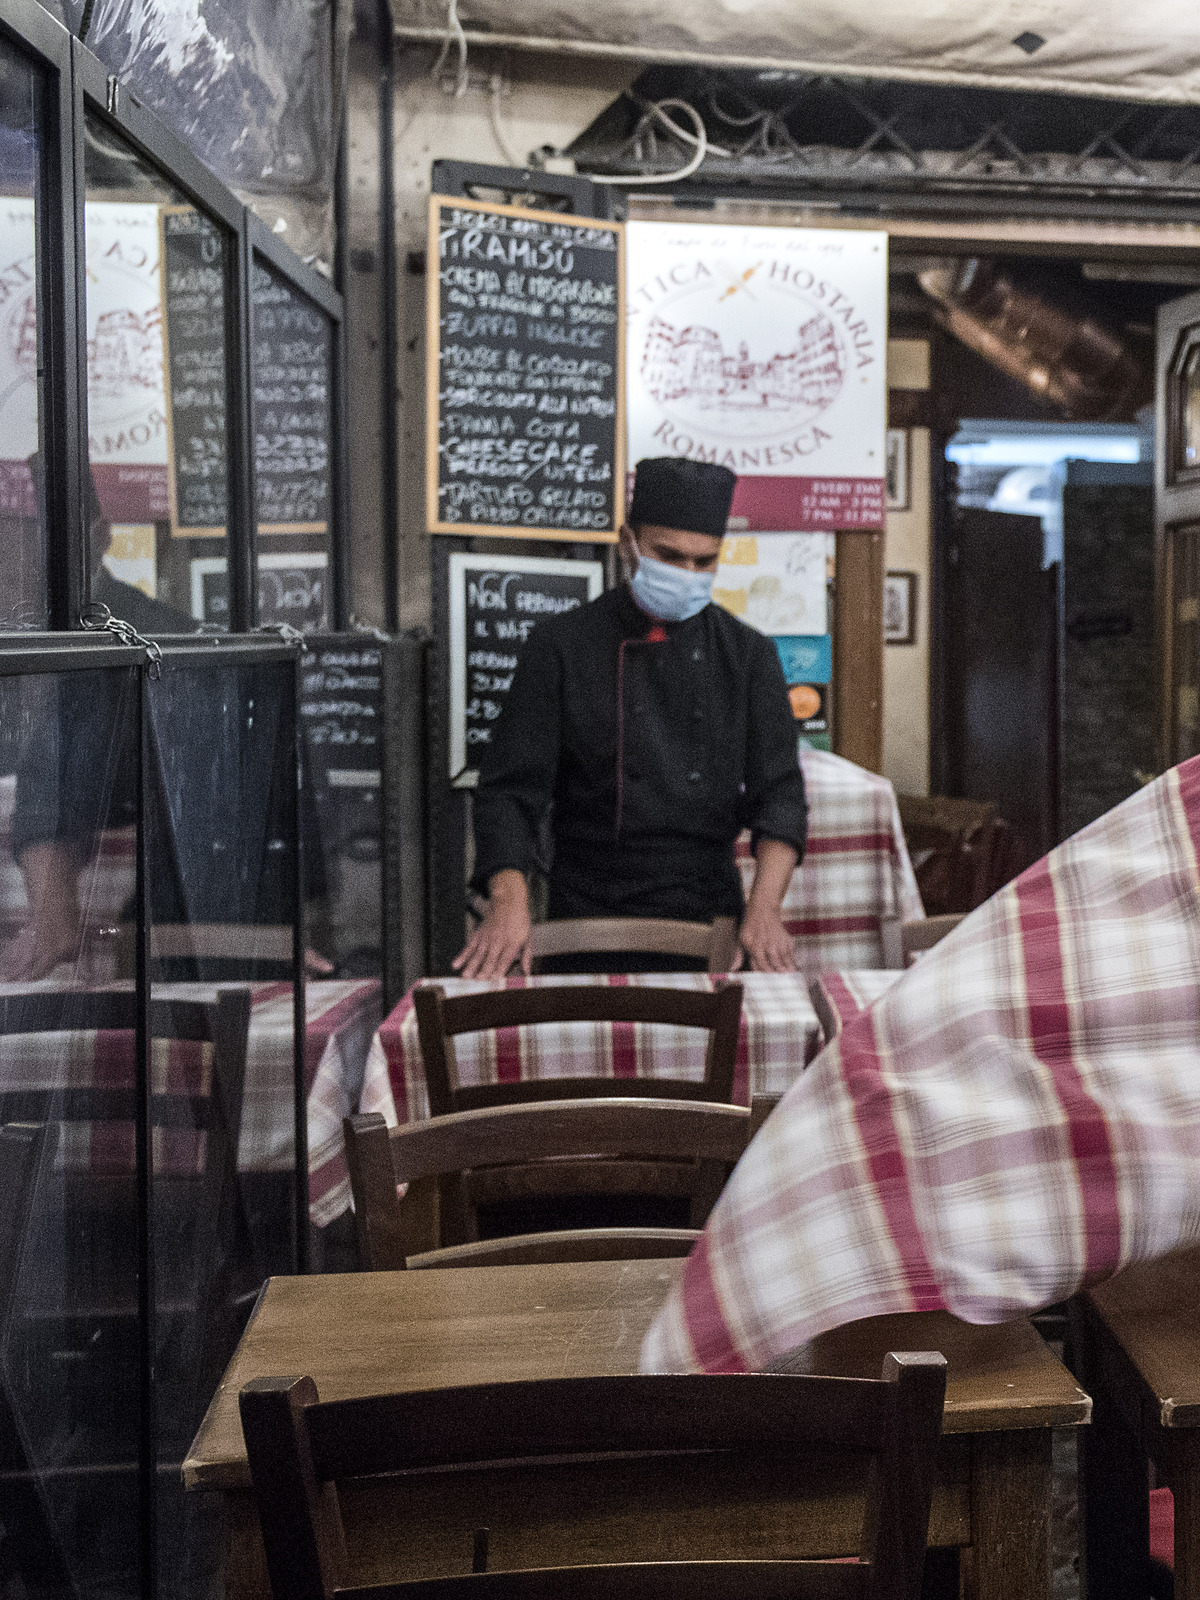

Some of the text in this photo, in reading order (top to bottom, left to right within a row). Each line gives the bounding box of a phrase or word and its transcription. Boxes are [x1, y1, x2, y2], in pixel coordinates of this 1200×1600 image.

[447, 310, 604, 349] ZUPPA INGLESE
[769, 260, 874, 369] HOSTARIA
[445, 436, 599, 467] CHEESECAKE
[653, 419, 832, 469] ROMANESCA
[445, 480, 535, 507] TARTUFO
[812, 481, 882, 495] EVERY DAY
